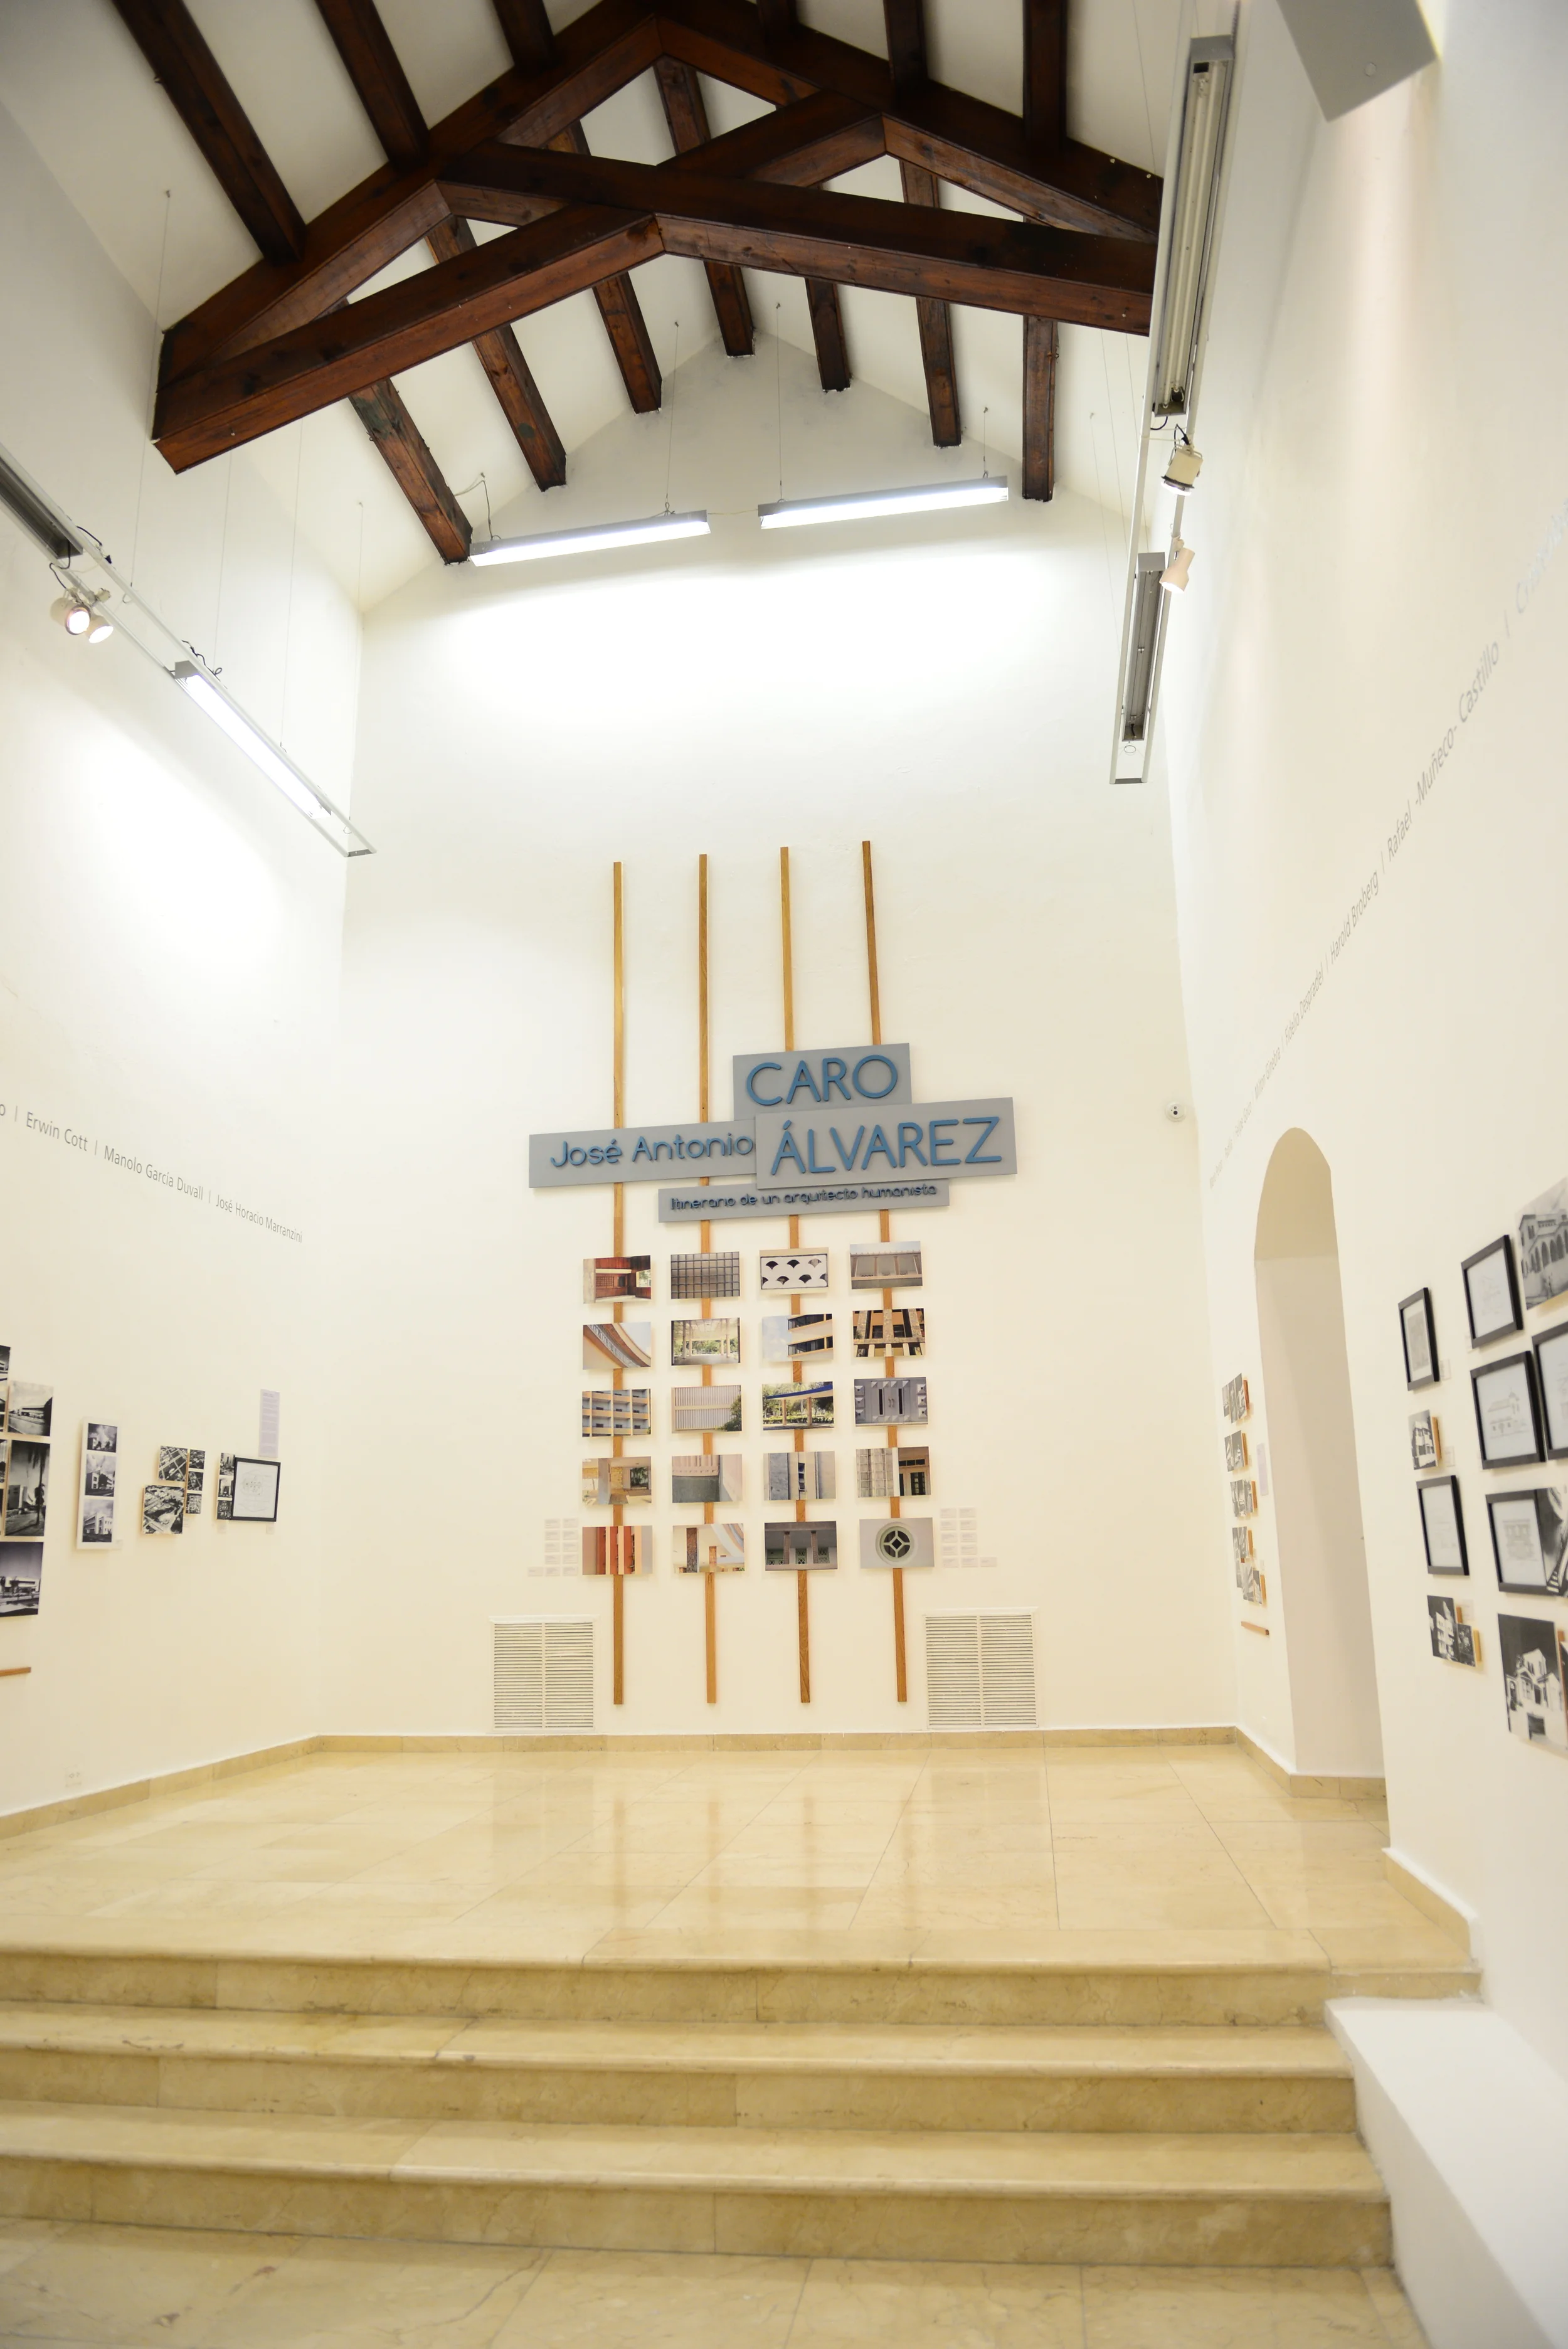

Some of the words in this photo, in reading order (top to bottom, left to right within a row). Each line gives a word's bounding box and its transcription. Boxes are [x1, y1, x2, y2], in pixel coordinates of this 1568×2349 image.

[1299, 961, 1324, 1020] Despradel
[1330, 913, 1351, 965] Harold
[1351, 869, 1379, 929] Broberg
[1387, 798, 1412, 862] Rafael
[1459, 640, 1499, 723] Castillo
[746, 1054, 898, 1106] CARO
[549, 1138, 622, 1167] José
[632, 1132, 753, 1162] Antonio
[771, 1115, 1003, 1175] ÁLVAREZ
[26, 1111, 60, 1140] Erwin
[64, 1128, 88, 1152] Cott
[104, 1145, 142, 1174] Manolo
[146, 1164, 174, 1187] García
[176, 1177, 203, 1201] Duvall
[216, 1194, 233, 1213] José
[235, 1202, 264, 1226] Horacio
[265, 1216, 302, 1244] Marranzini
[739, 1193, 758, 1206] de
[761, 1194, 780, 1205] un
[784, 1187, 858, 1205] arquitecto
[861, 1183, 937, 1199] humanista
